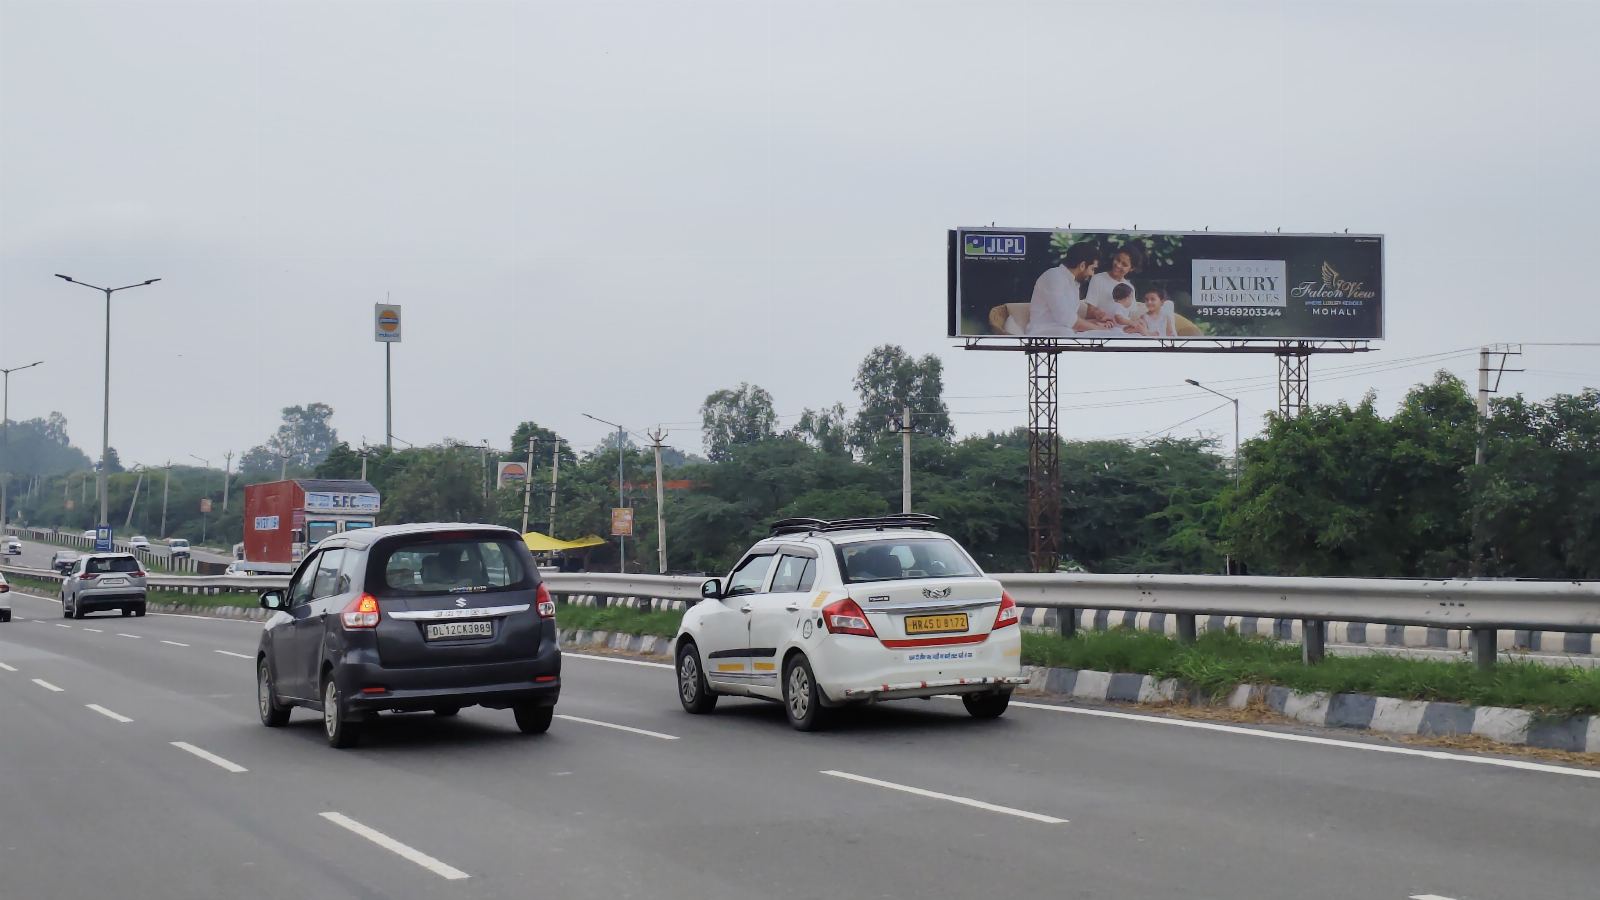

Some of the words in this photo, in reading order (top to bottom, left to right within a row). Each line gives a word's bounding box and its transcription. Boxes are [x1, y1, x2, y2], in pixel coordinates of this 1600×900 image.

[986, 238, 1023, 253] JLPL
[1200, 276, 1279, 291] LUXURY
[1291, 281, 1344, 298] Falcon
[1338, 280, 1375, 298] View
[1200, 293, 1280, 304] RESIDENCES
[1197, 307, 1281, 317] +91-9569203344
[1312, 308, 1356, 316] MOHALI
[912, 619, 934, 630] HR45
